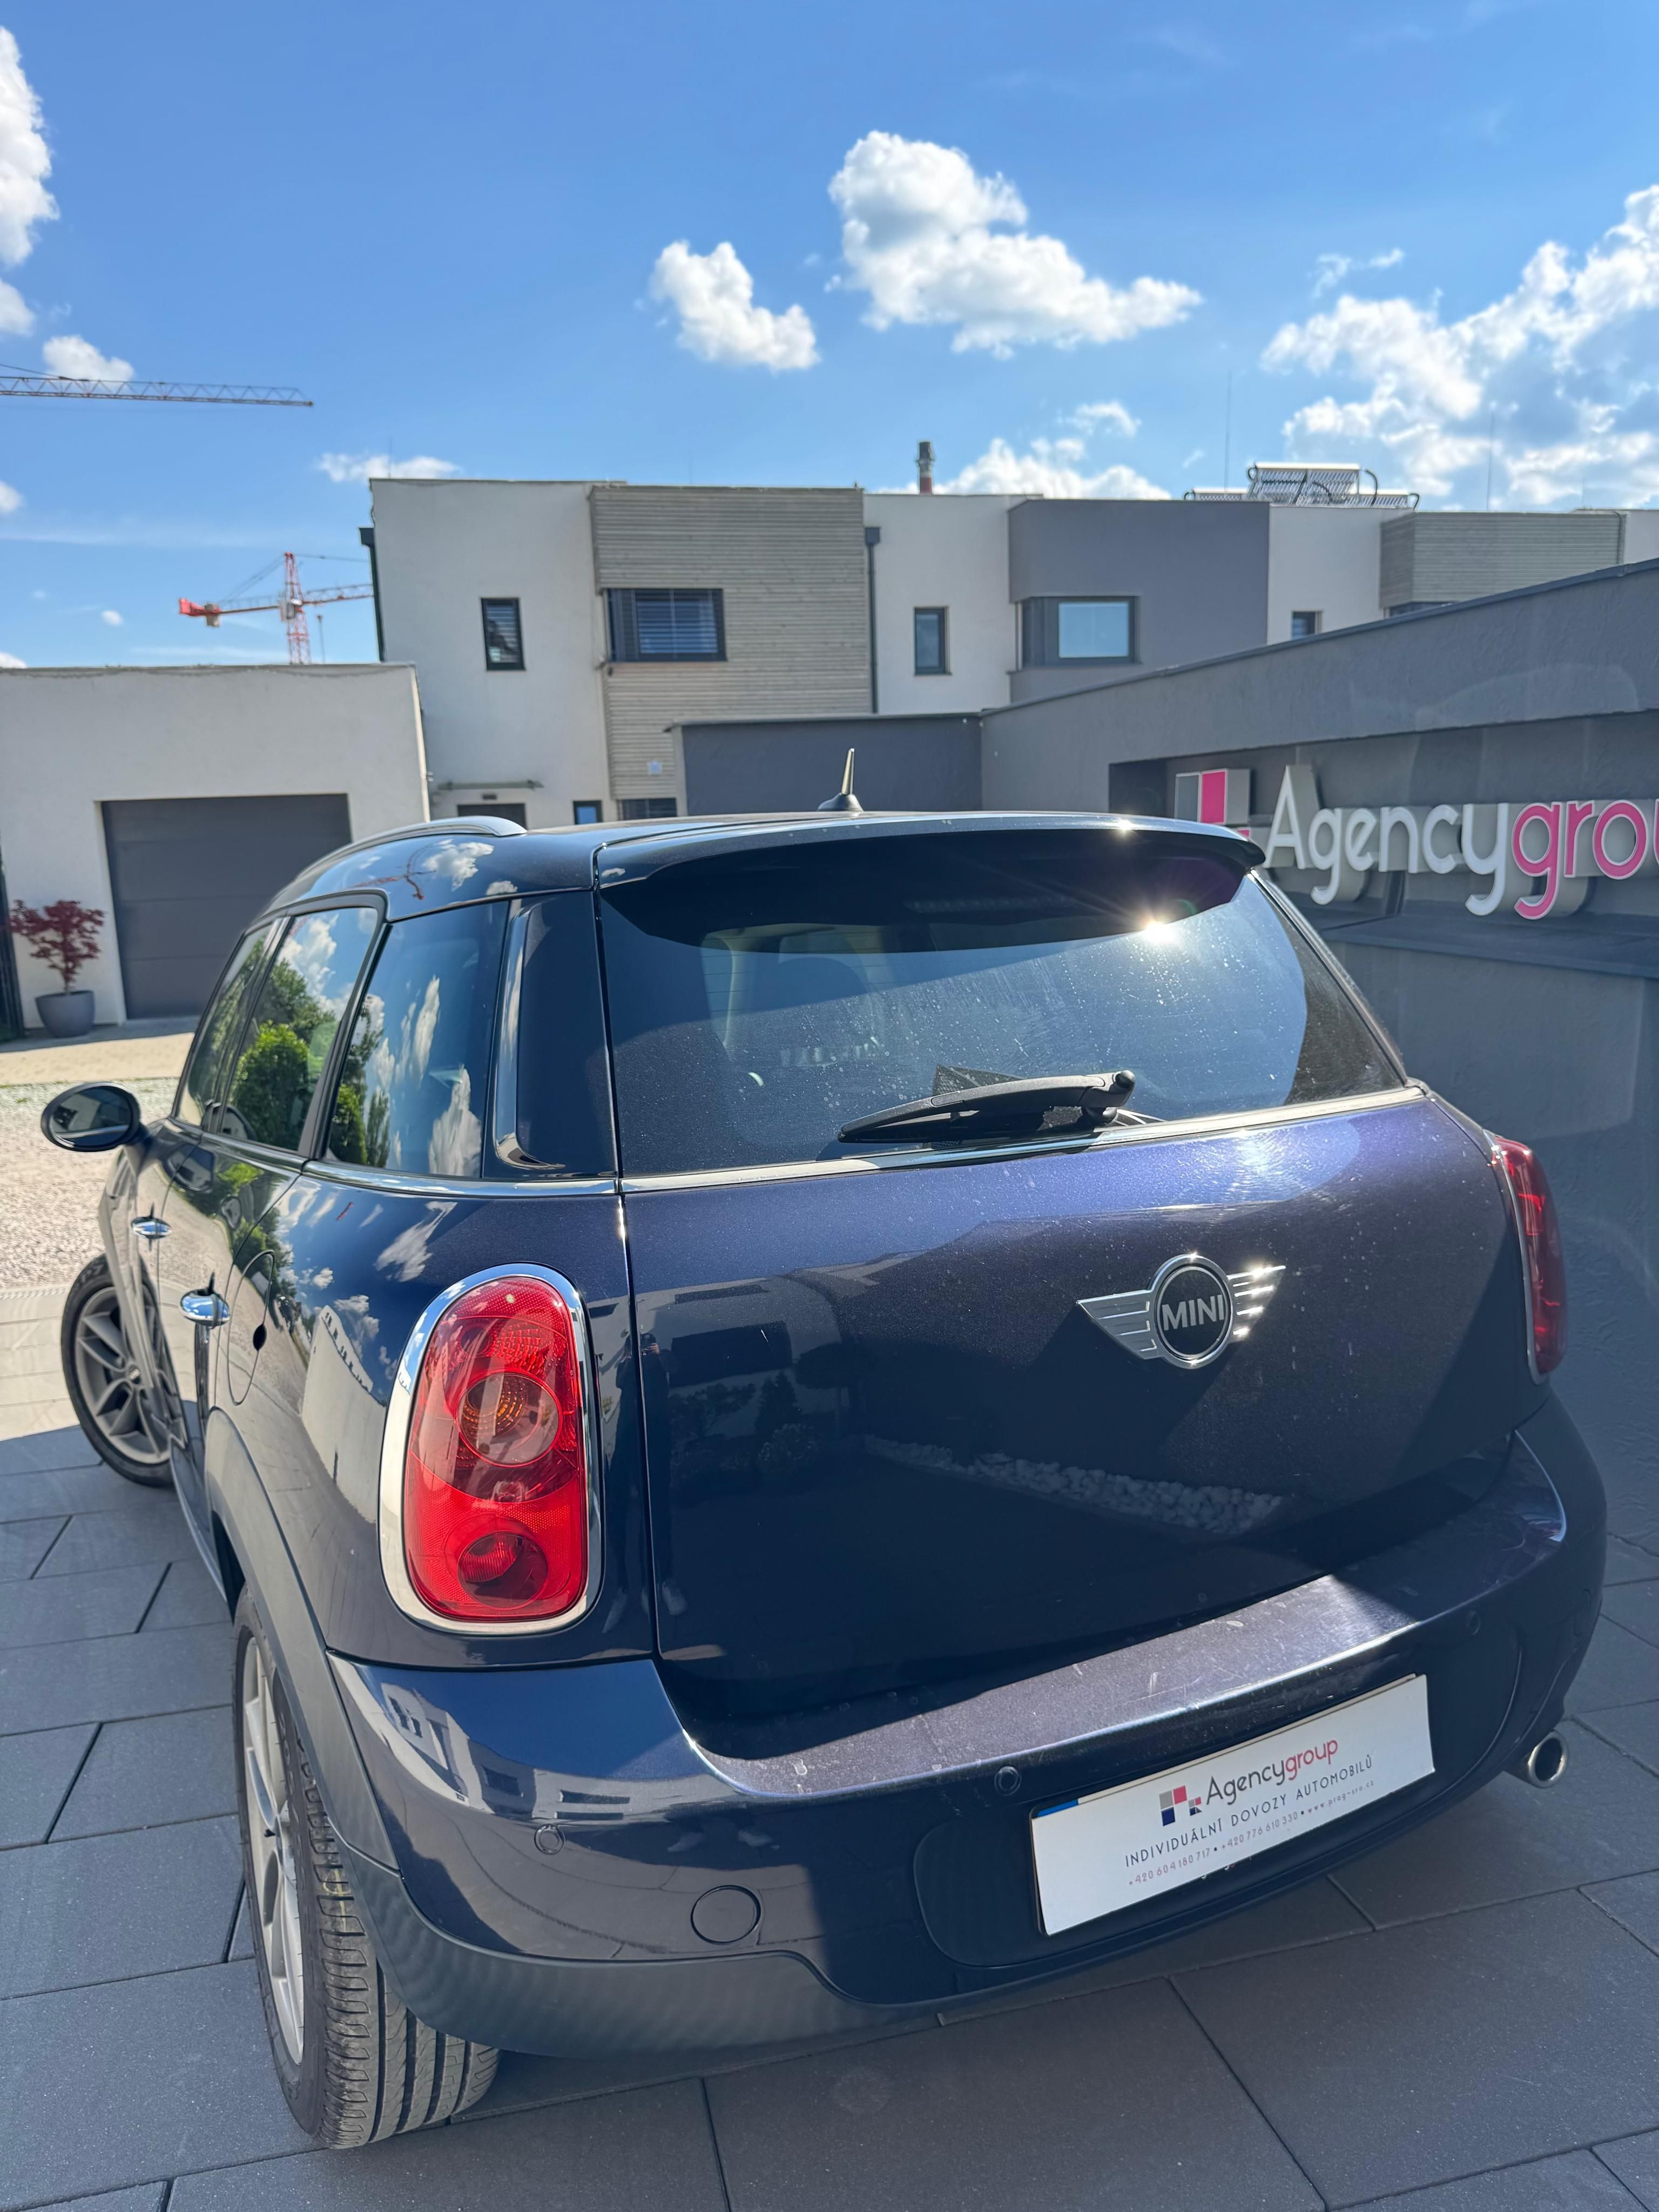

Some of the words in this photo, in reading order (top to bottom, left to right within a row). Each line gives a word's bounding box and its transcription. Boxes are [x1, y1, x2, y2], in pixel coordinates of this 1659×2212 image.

[1265, 764, 1659, 920] Agencygro
[1162, 1294, 1225, 1331] MINI
[1206, 1739, 1338, 1805] Agencygroup
[1125, 1818, 1223, 1867] INDIVIDUÁLNÍ
[1231, 1793, 1287, 1826] DOVOZY
[1296, 1754, 1372, 1800] AUTOMOBILŮ
[1156, 1862, 1177, 1876] 604
[1178, 1854, 1193, 1868] 180
[1196, 1847, 1210, 1861] 717
[1246, 1826, 1263, 1840] 776
[1265, 1819, 1280, 1832] 610
[1282, 1811, 1298, 1824] 330
